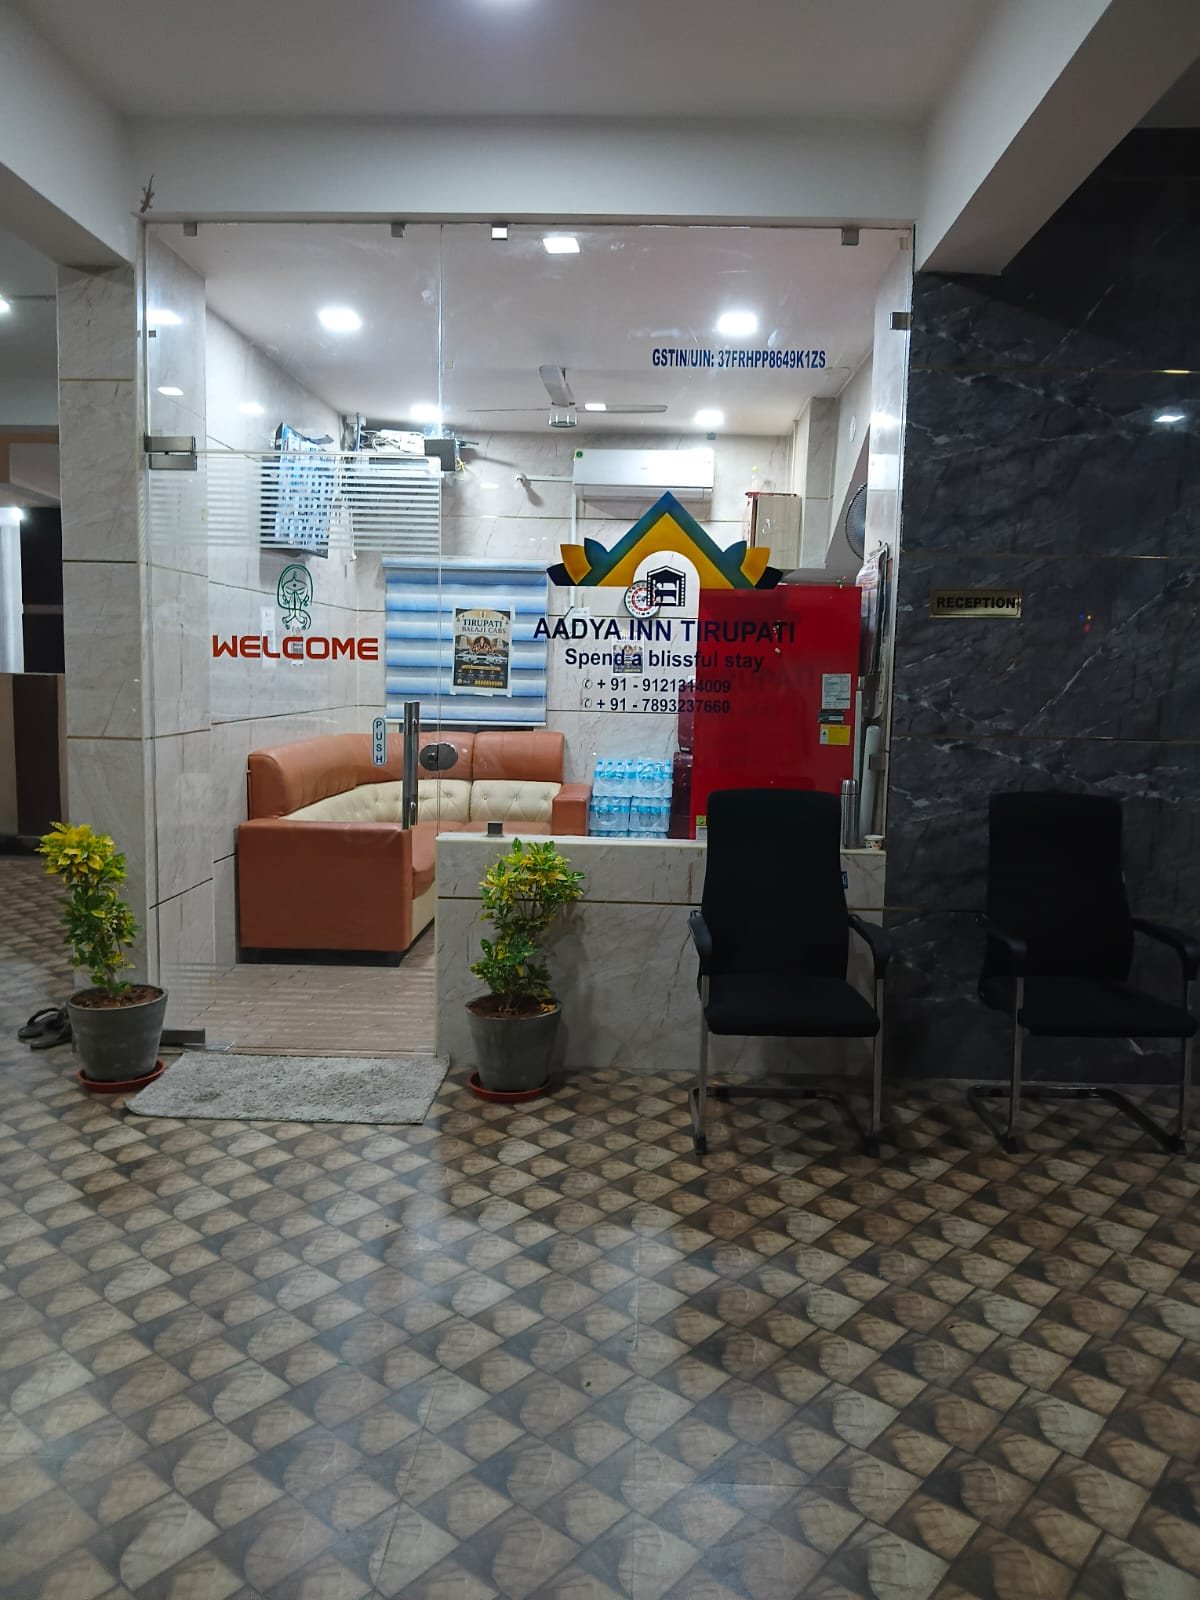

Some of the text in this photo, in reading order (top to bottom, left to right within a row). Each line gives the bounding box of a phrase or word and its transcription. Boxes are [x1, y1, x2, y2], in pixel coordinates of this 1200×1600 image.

[652, 349, 714, 367] GSTIN/UIN:
[937, 596, 1016, 609] RECEPTION
[462, 618, 503, 628] TIRUPATI
[533, 617, 622, 640] AADYA
[630, 619, 672, 641] INN
[680, 620, 796, 643] TIRUPATI
[212, 634, 379, 661] WELCOME
[565, 648, 625, 669] Spend
[631, 653, 642, 666] a
[648, 649, 718, 667] blissful
[725, 652, 764, 671] stay
[610, 677, 627, 691] 91
[610, 697, 626, 711] 91
[642, 698, 730, 713] 7893237660
[375, 720, 383, 763] PUSH
